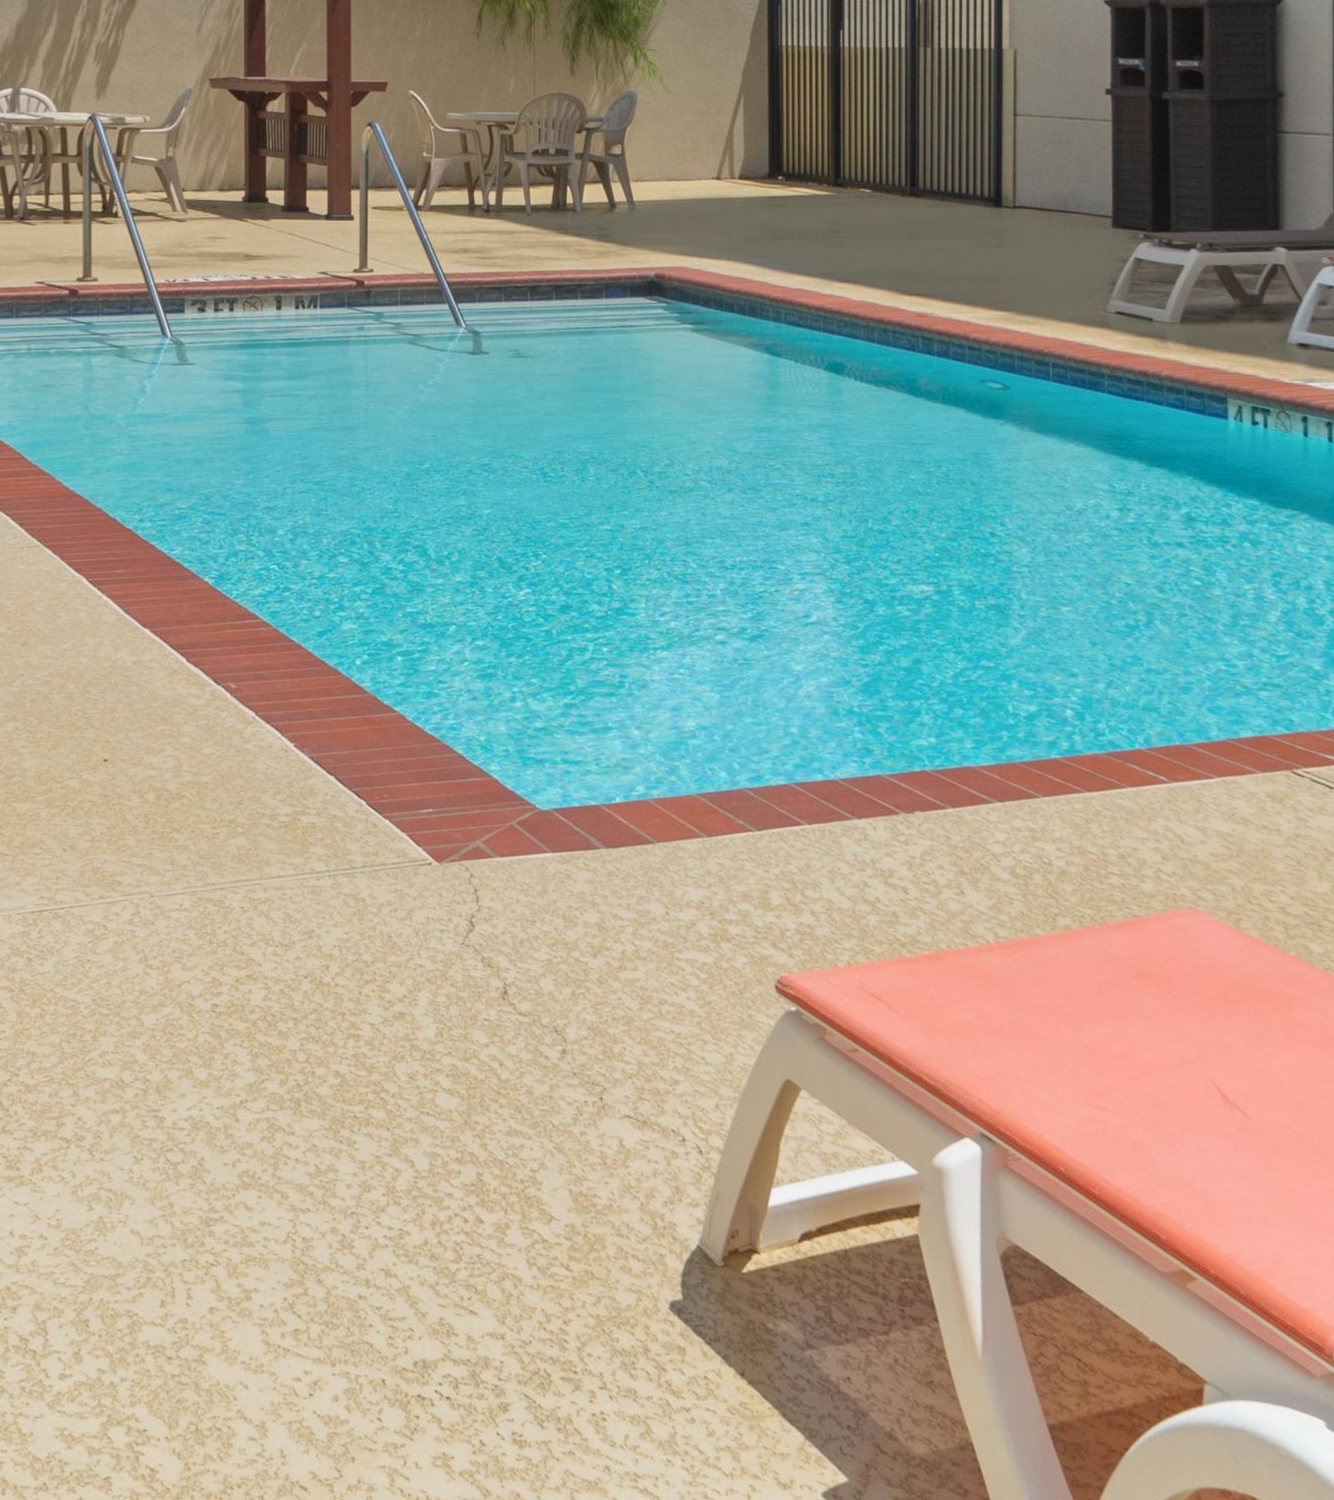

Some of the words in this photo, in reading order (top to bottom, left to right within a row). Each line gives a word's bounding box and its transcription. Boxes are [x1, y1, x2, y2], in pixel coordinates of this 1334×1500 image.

[273, 294, 283, 311] 1
[294, 294, 318, 310] M
[1233, 404, 1244, 424] 4
[1250, 404, 1271, 430] FT
[1300, 415, 1309, 438] 1
[1324, 420, 1334, 444] 1
